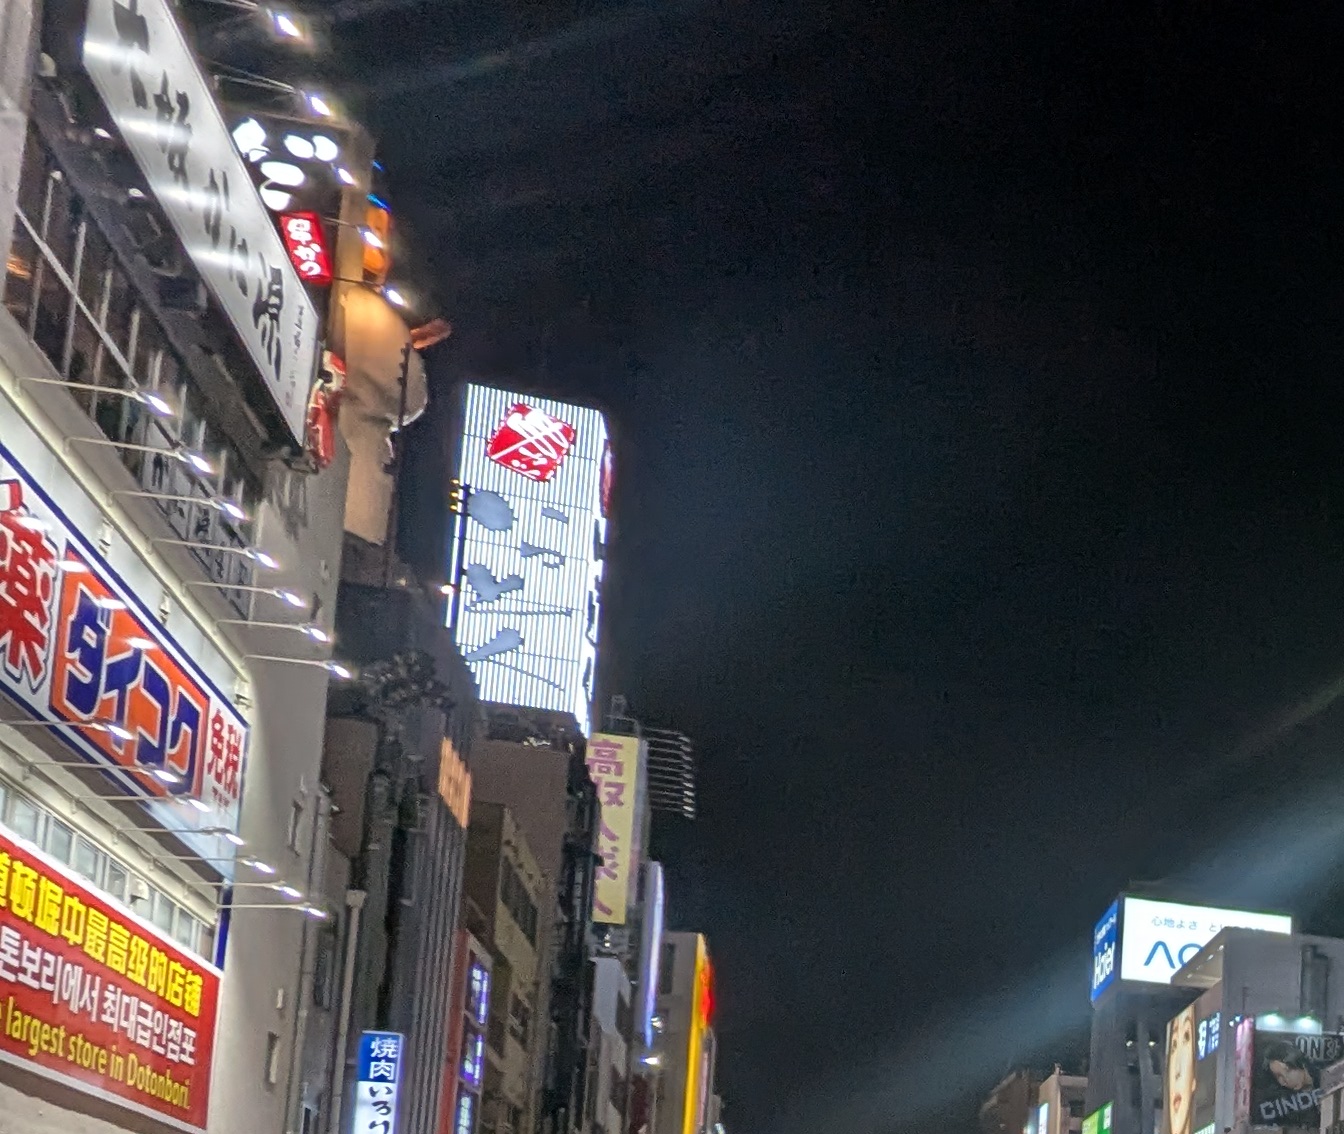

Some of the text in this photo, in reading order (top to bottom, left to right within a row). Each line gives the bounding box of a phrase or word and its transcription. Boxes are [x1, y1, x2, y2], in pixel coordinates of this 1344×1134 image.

[206, 706, 241, 801] 免税
[5, 995, 66, 1057] largest
[67, 1033, 108, 1075] store
[110, 1045, 124, 1080] in
[100, 983, 197, 1066] 최대급인점포
[368, 1037, 399, 1081] 焼肉
